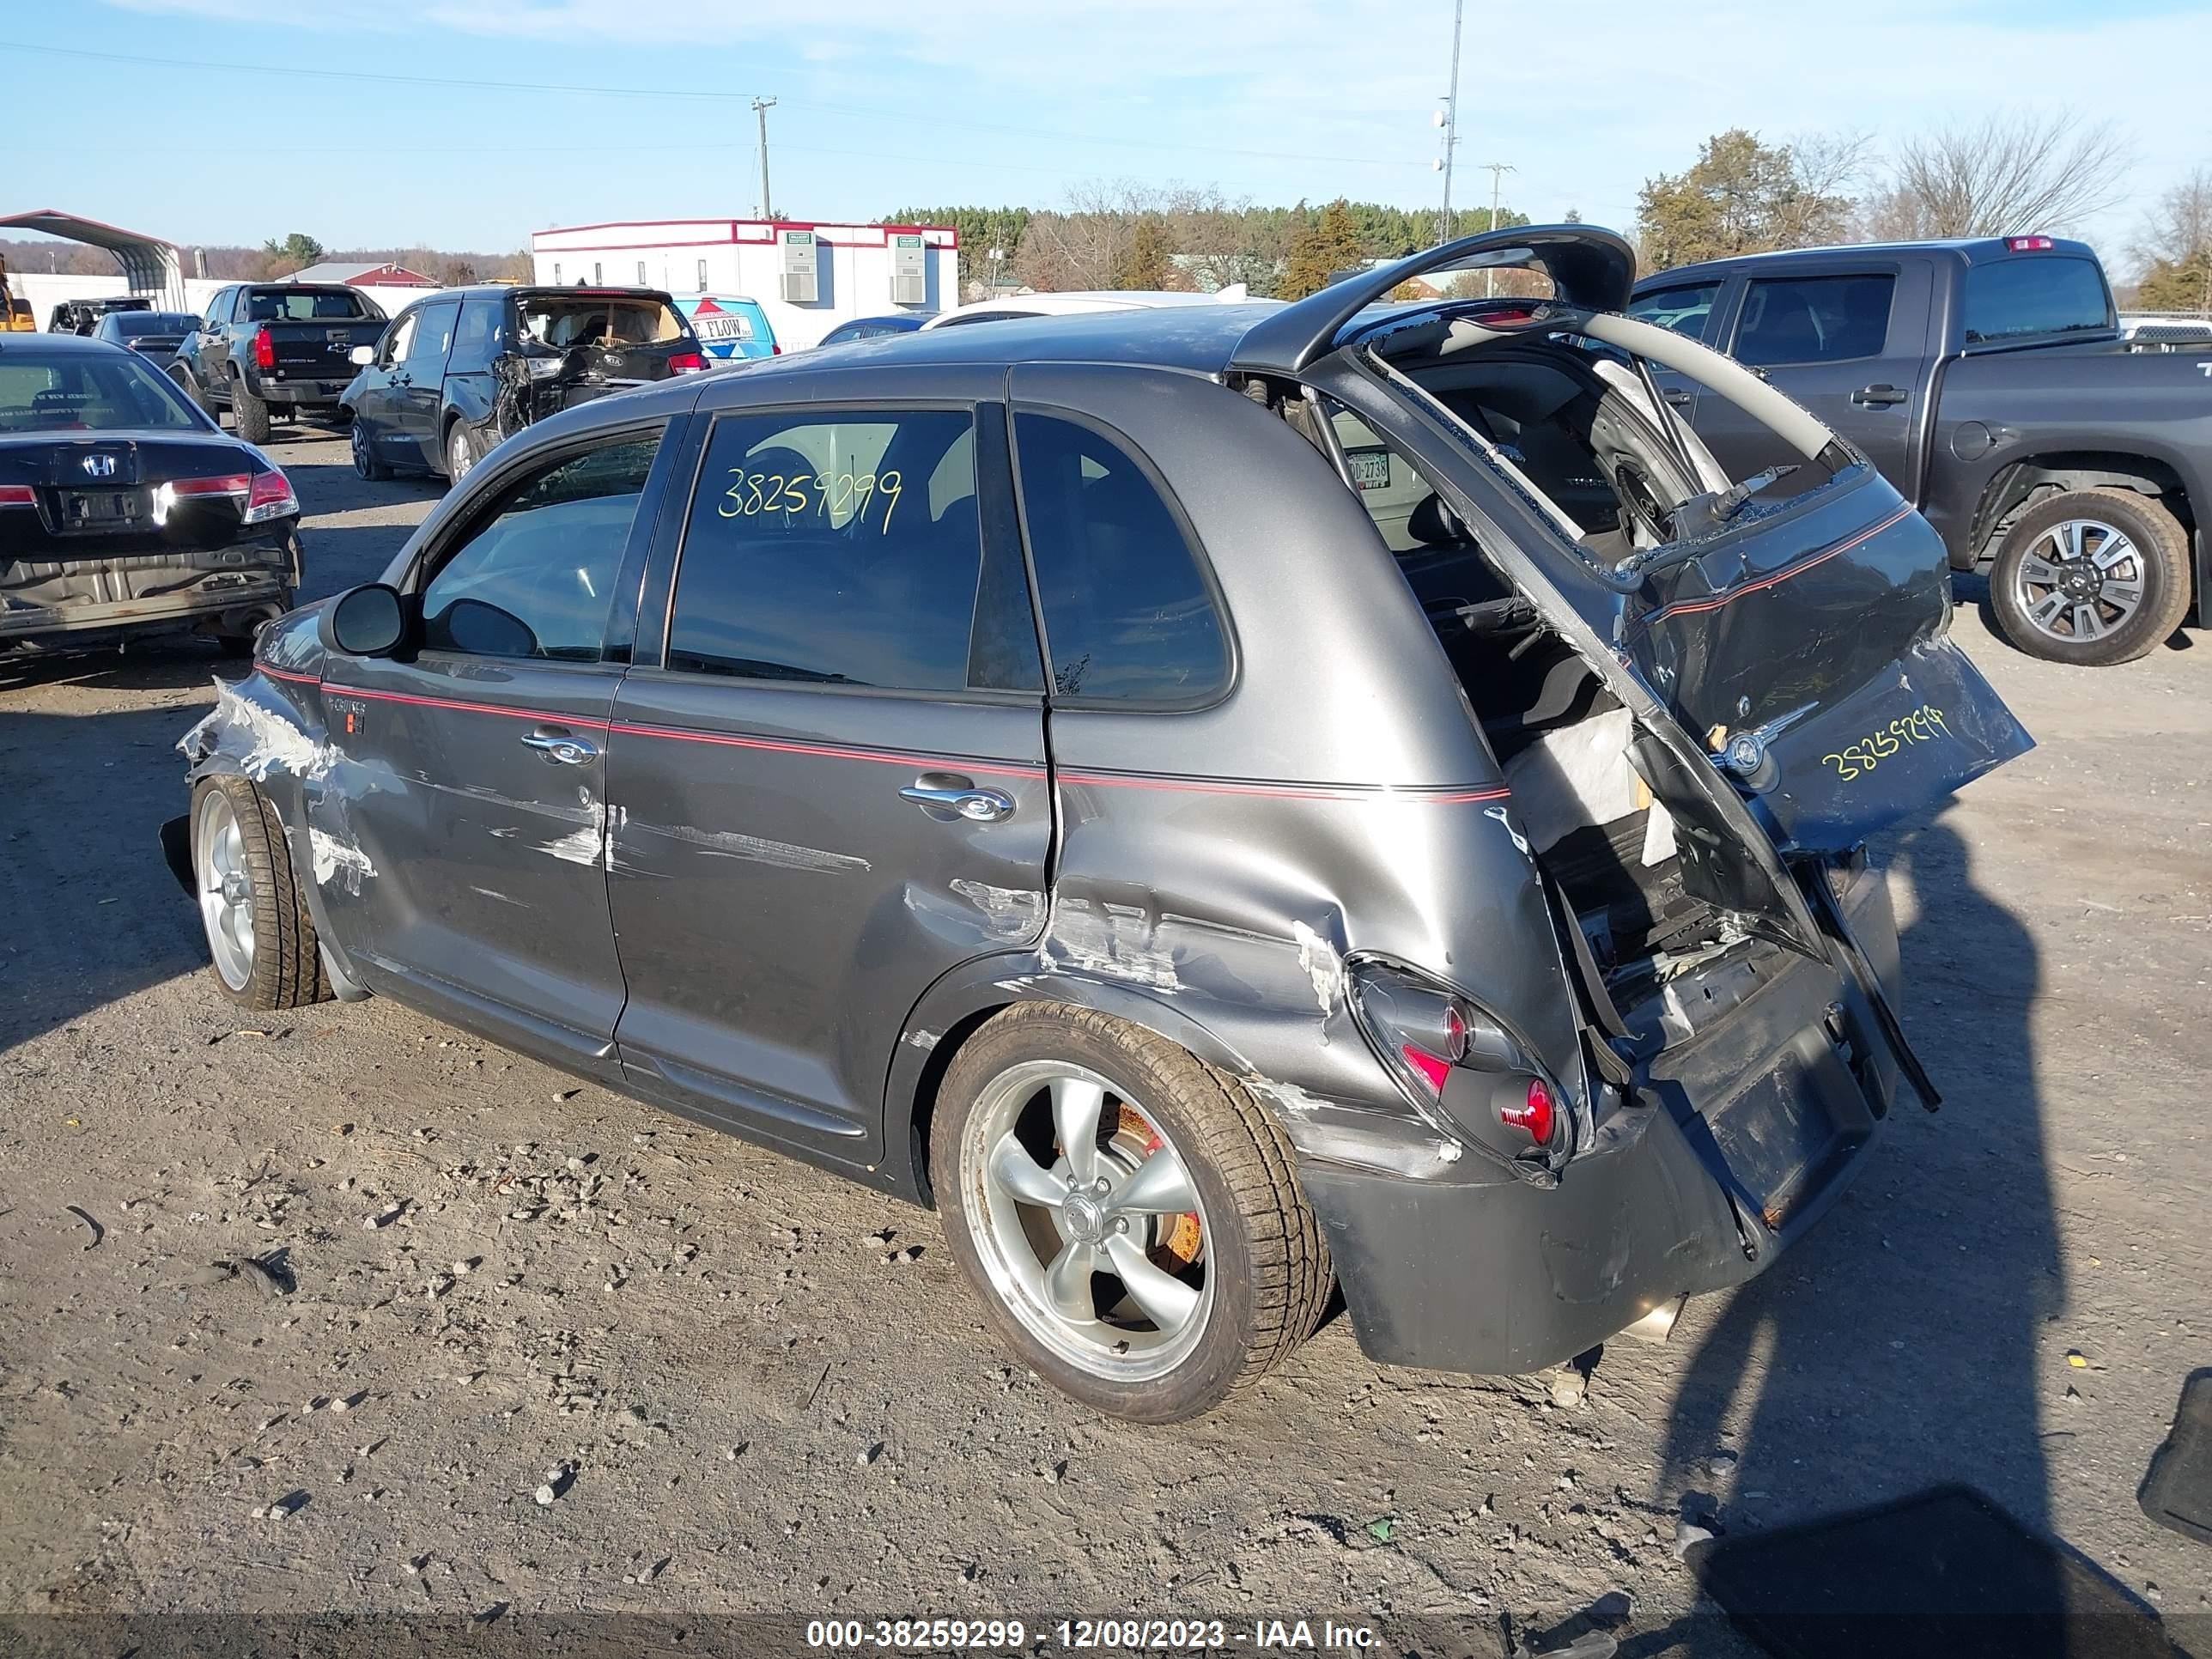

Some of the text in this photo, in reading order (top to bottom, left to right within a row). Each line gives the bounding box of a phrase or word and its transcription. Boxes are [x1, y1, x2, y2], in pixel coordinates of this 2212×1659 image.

[706, 319, 741, 337] FLOW
[718, 468, 902, 535] 38259299
[1822, 704, 1954, 781] 38259299
